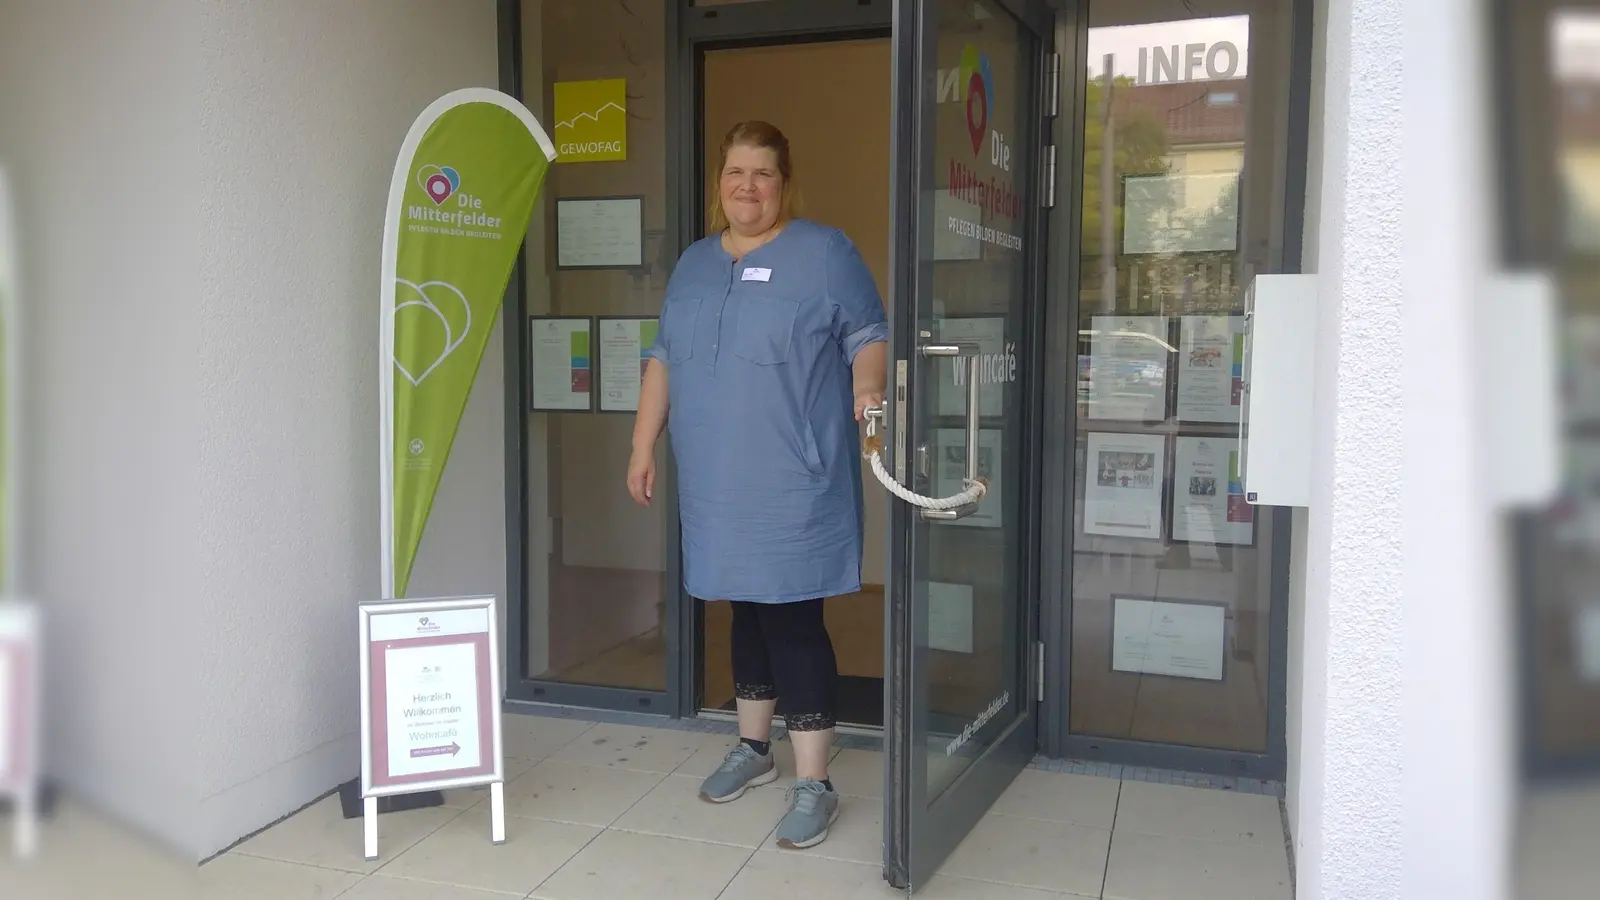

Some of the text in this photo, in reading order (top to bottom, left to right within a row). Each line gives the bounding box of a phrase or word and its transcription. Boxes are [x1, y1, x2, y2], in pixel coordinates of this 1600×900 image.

[1138, 41, 1239, 84] INFO
[560, 141, 621, 155] GEWOFAG
[991, 129, 1010, 172] Die
[949, 157, 1022, 221] Mitterfelder
[458, 193, 482, 209] Die
[407, 205, 502, 227] Mitterfelder
[948, 216, 1022, 252] PFLEGEN BILDEN BEGLEITEN
[413, 692, 452, 703] Herzlich
[403, 706, 462, 718] Willkommen
